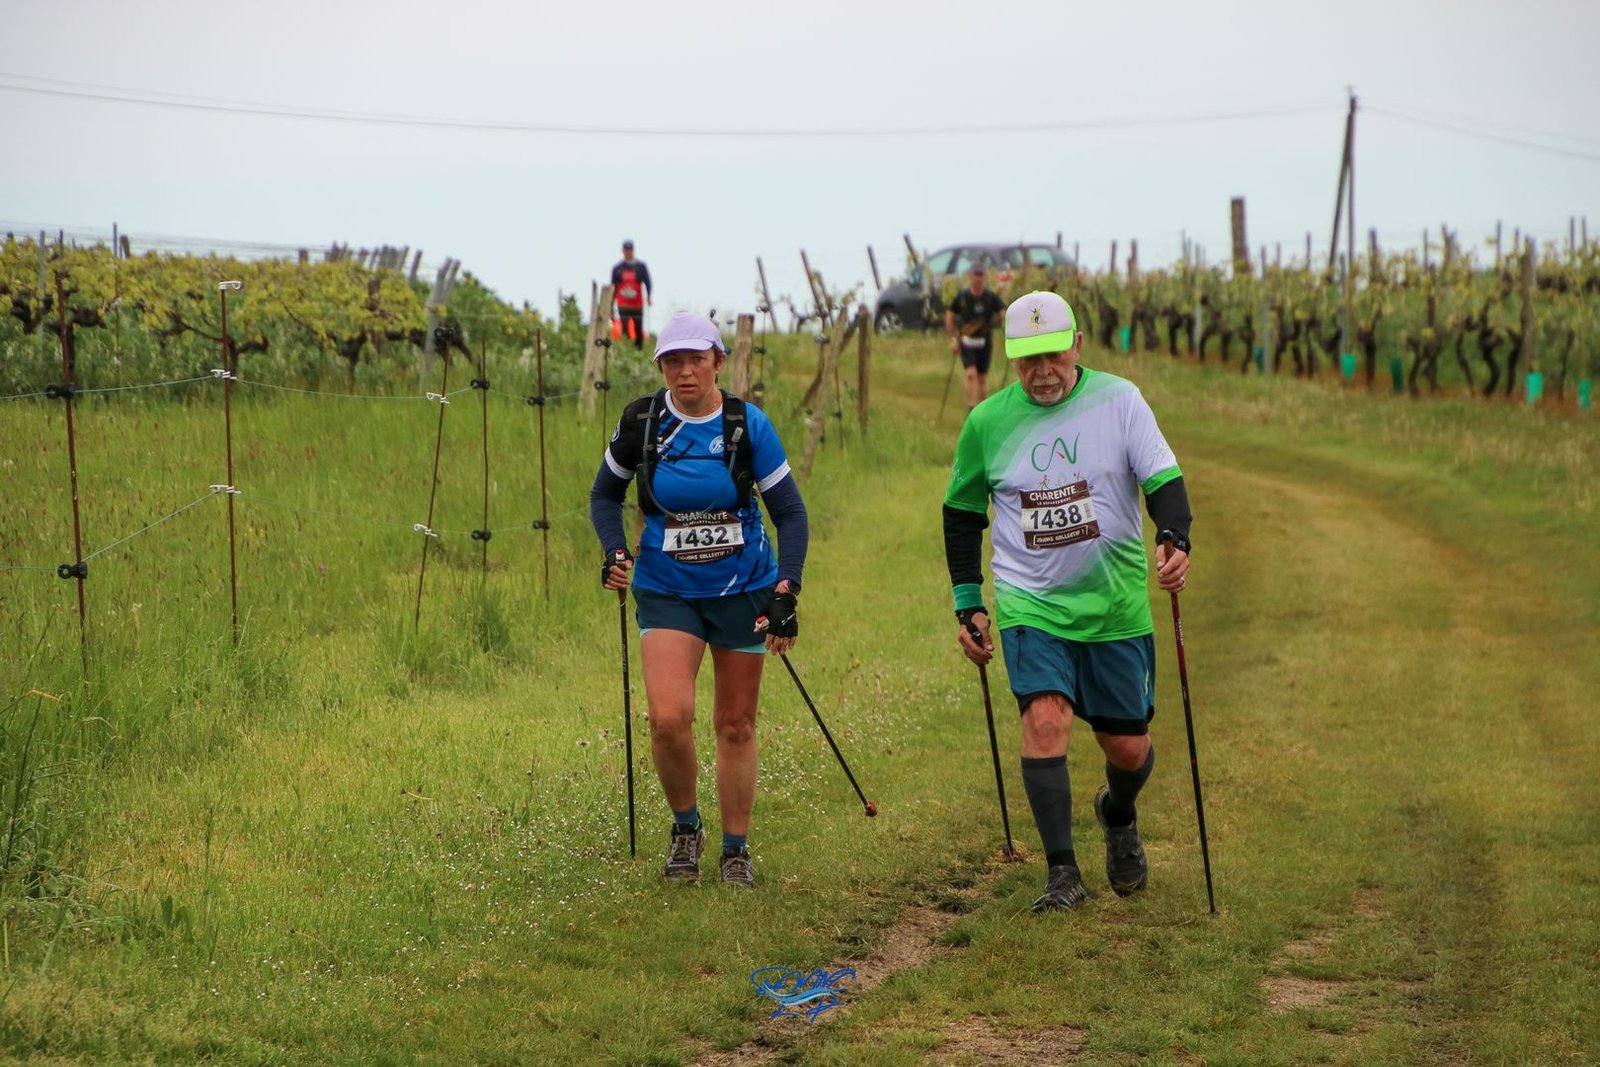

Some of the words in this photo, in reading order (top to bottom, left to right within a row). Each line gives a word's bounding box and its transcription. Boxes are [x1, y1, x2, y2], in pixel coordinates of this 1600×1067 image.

[1029, 485, 1077, 502] CHARENTE
[676, 511, 728, 522] CHARENTE
[1030, 504, 1082, 530] 1438
[674, 526, 729, 548] 1432
